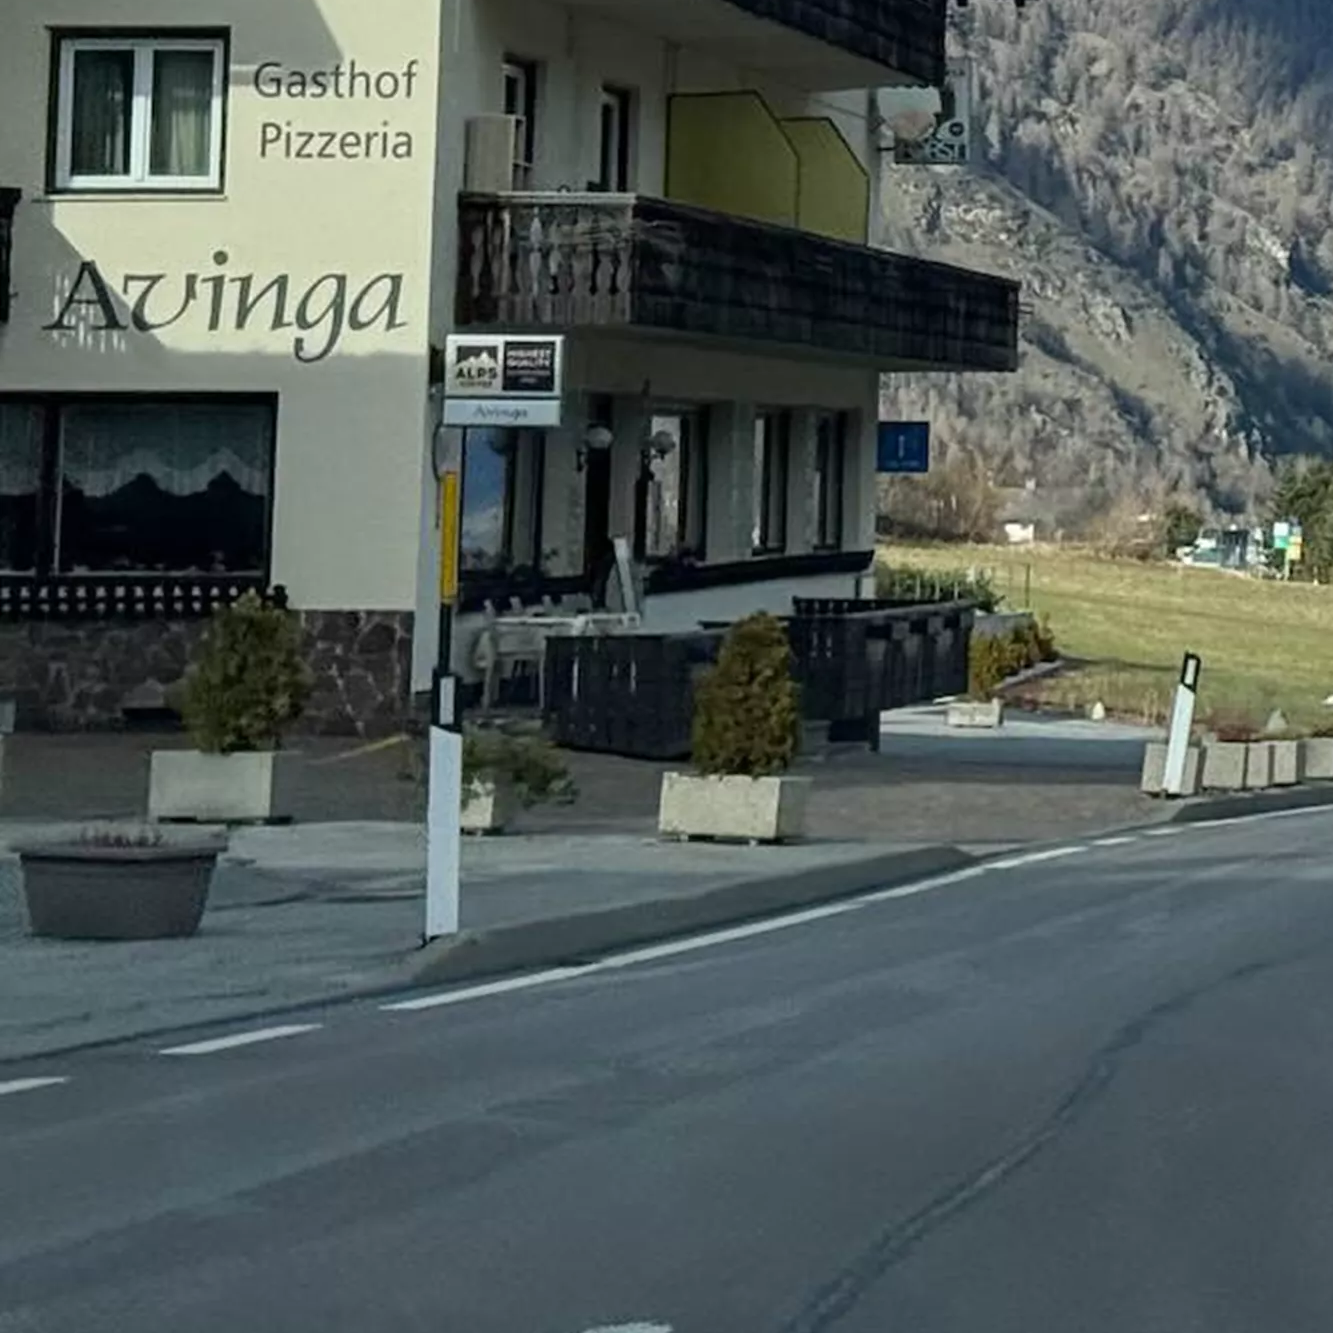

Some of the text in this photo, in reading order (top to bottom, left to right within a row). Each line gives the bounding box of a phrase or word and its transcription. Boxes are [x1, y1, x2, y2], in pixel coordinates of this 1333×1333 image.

[254, 59, 419, 98] Gasthof
[260, 120, 413, 159] Pizzeria
[42, 250, 408, 363] Avinga
[456, 367, 497, 379] ALPS
